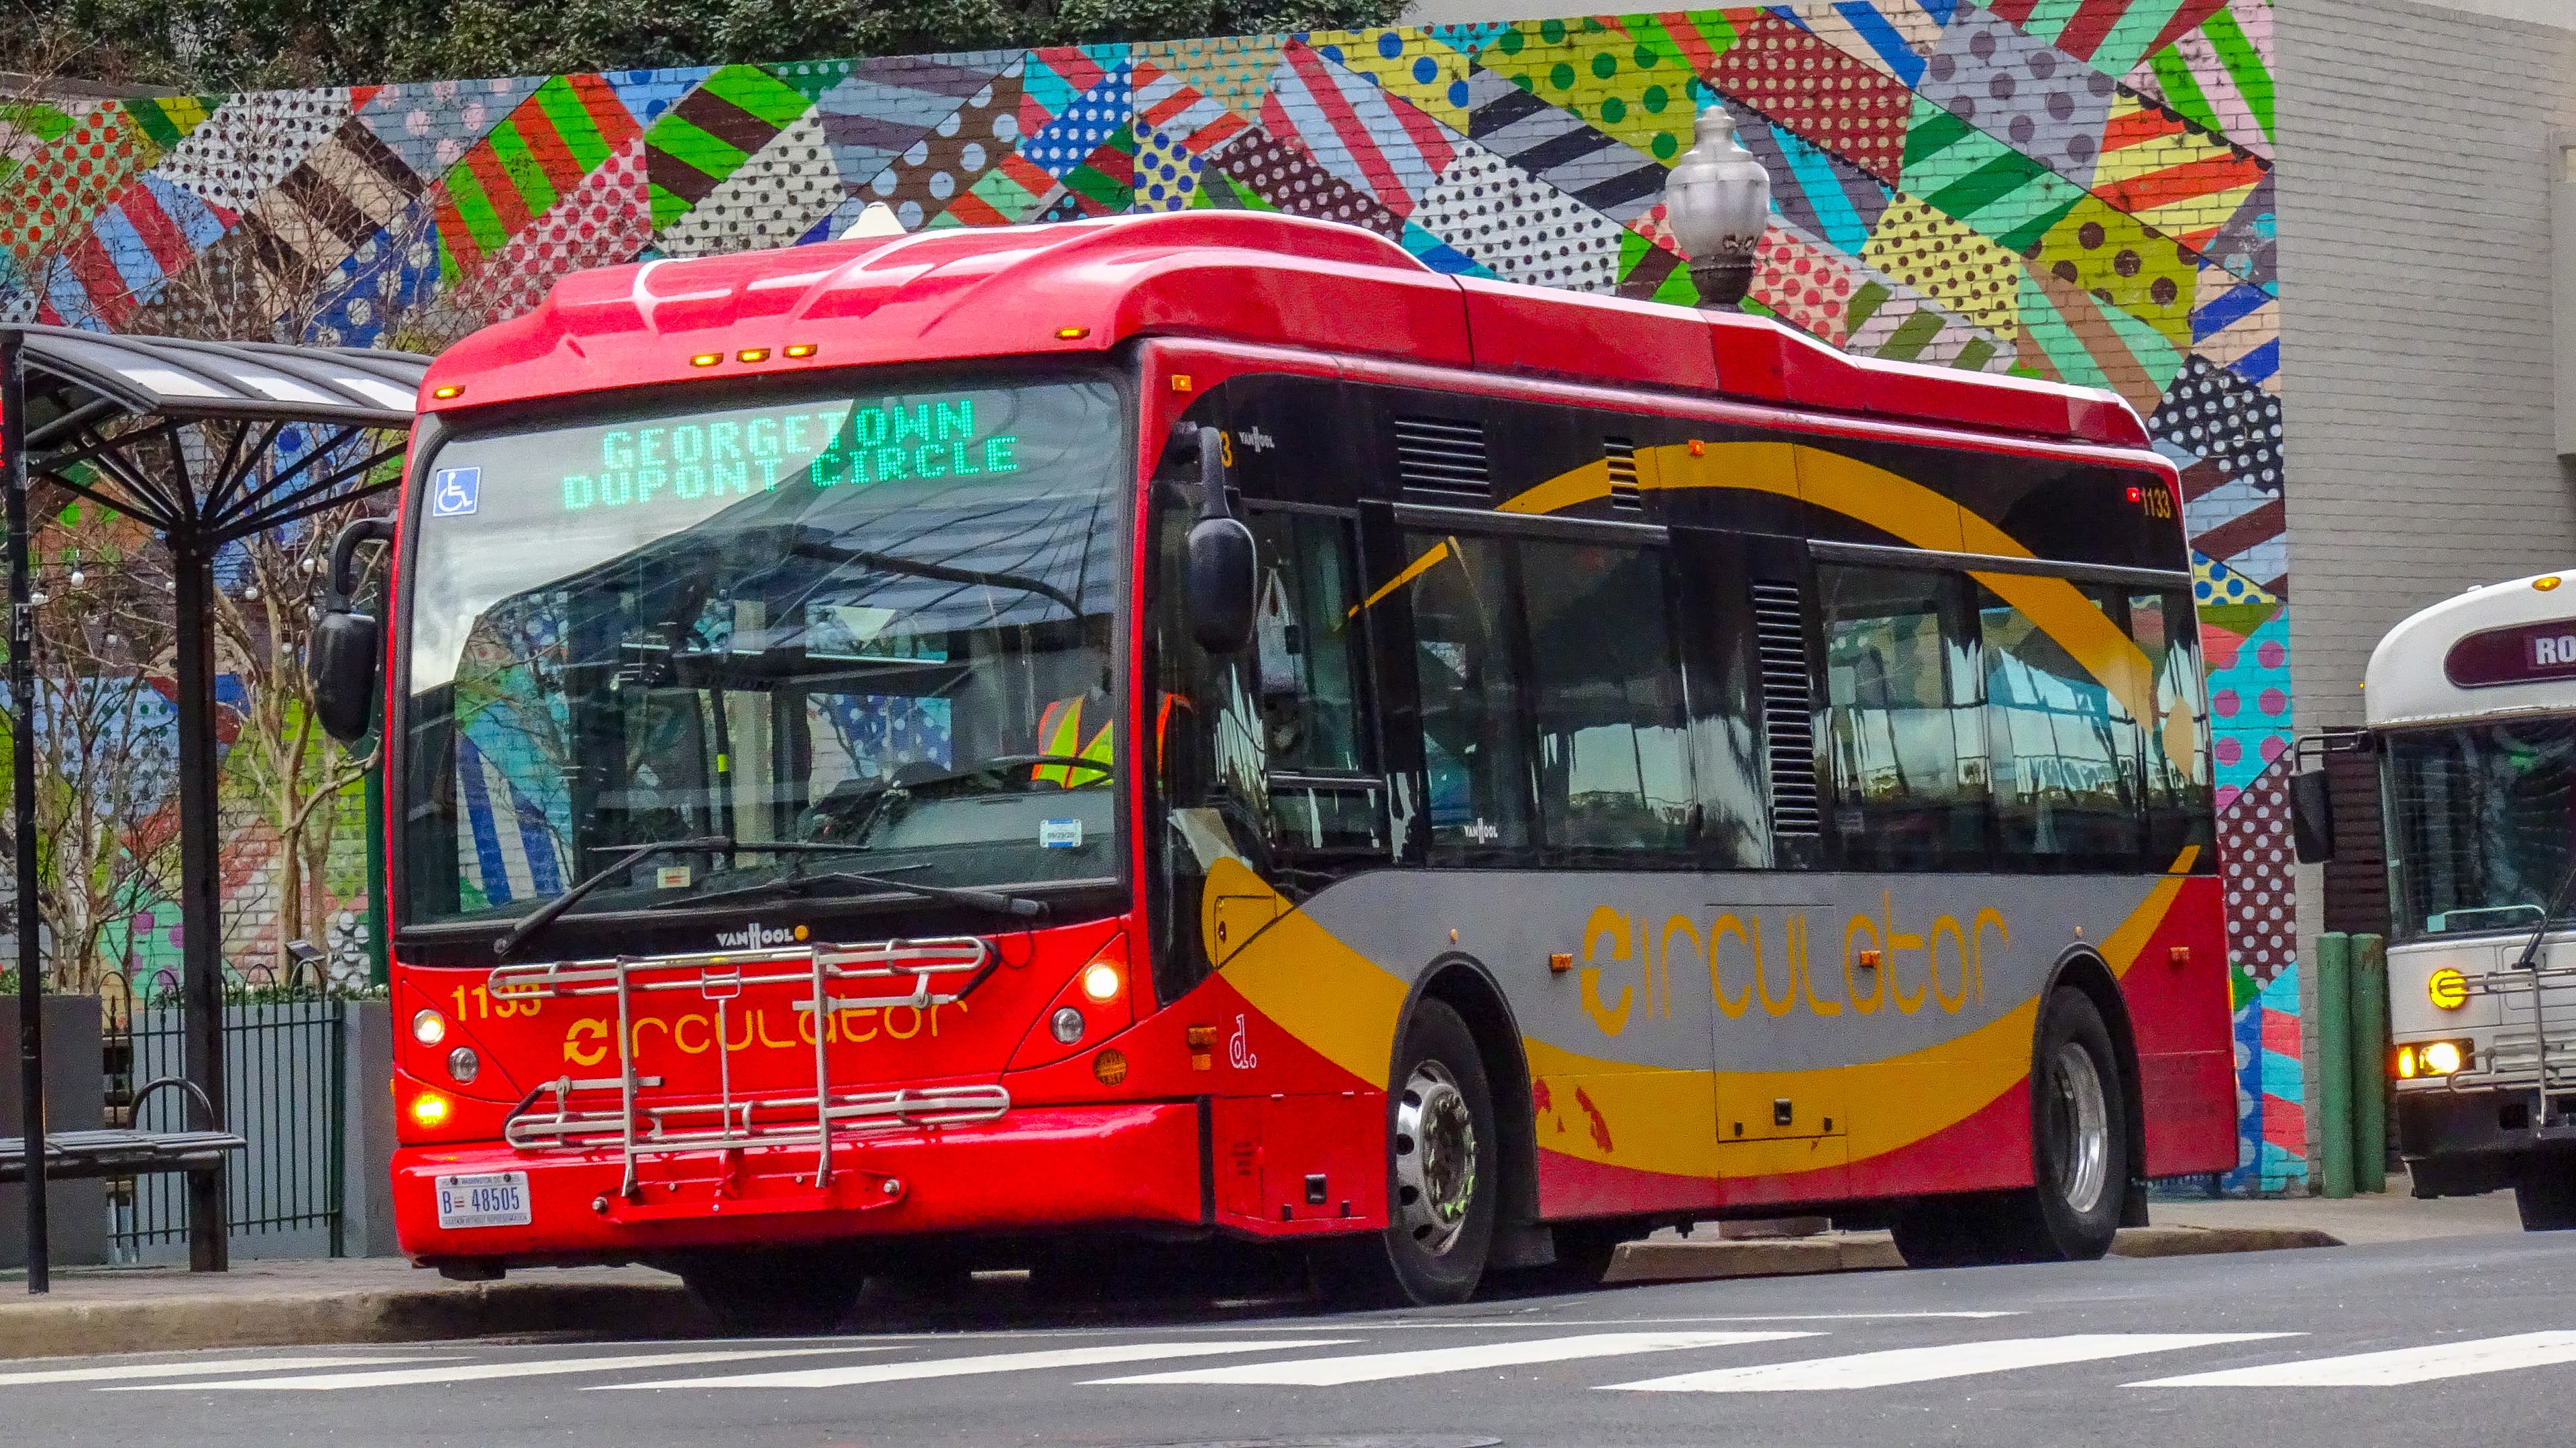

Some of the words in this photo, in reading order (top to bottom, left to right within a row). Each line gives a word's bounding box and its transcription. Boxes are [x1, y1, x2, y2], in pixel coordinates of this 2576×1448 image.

[603, 398, 974, 470] GEORGETOWN
[562, 455, 784, 511] DUPONT
[810, 435, 1020, 488] CIRCLE
[2140, 486, 2171, 519] 1133
[450, 984, 542, 1021] 1133
[442, 1190, 452, 1214] B
[472, 1186, 520, 1212] 48505
